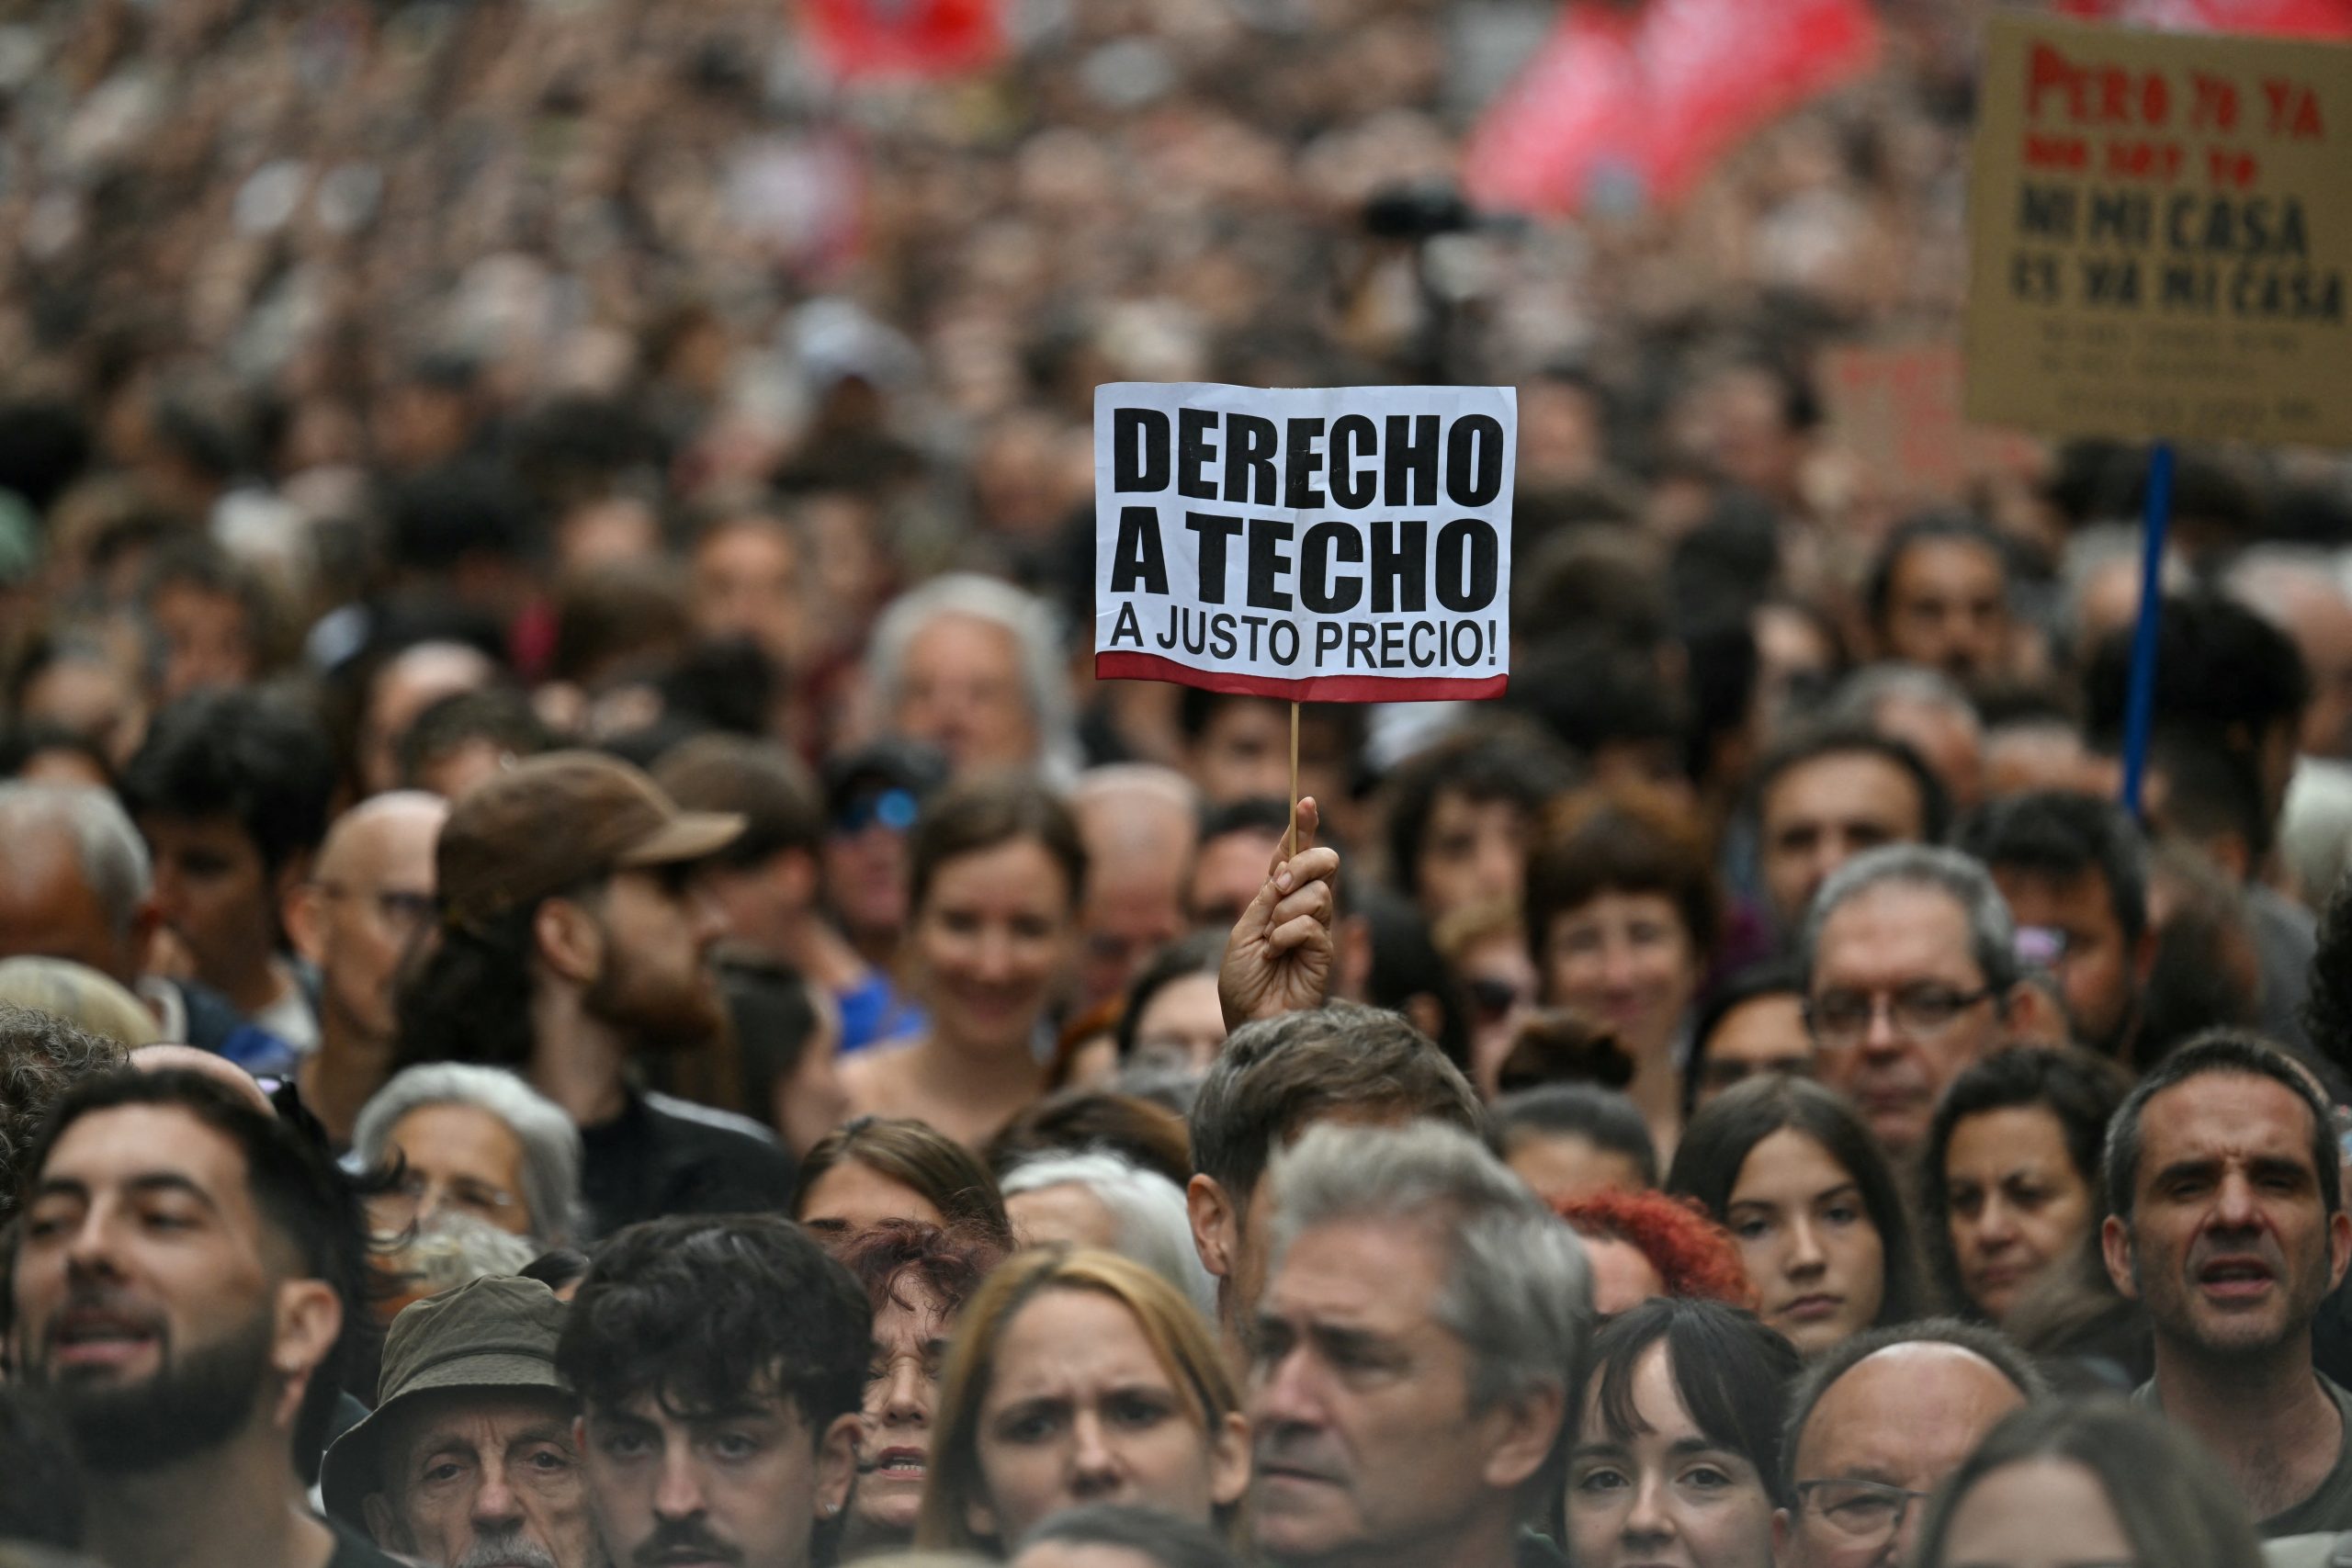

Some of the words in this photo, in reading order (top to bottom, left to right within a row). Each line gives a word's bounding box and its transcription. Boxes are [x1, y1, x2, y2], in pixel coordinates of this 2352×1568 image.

[2264, 81, 2324, 138] YA
[2089, 189, 2151, 246] MI
[2168, 196, 2308, 257] CASA
[2232, 266, 2345, 323] CASA
[1114, 407, 1504, 510] DERECHO
[1110, 506, 1170, 595] A
[1185, 511, 1498, 615] TECHO
[1110, 601, 1144, 647] A
[1156, 604, 1300, 666] JUSTO
[1315, 619, 1497, 669] PRECIO!
